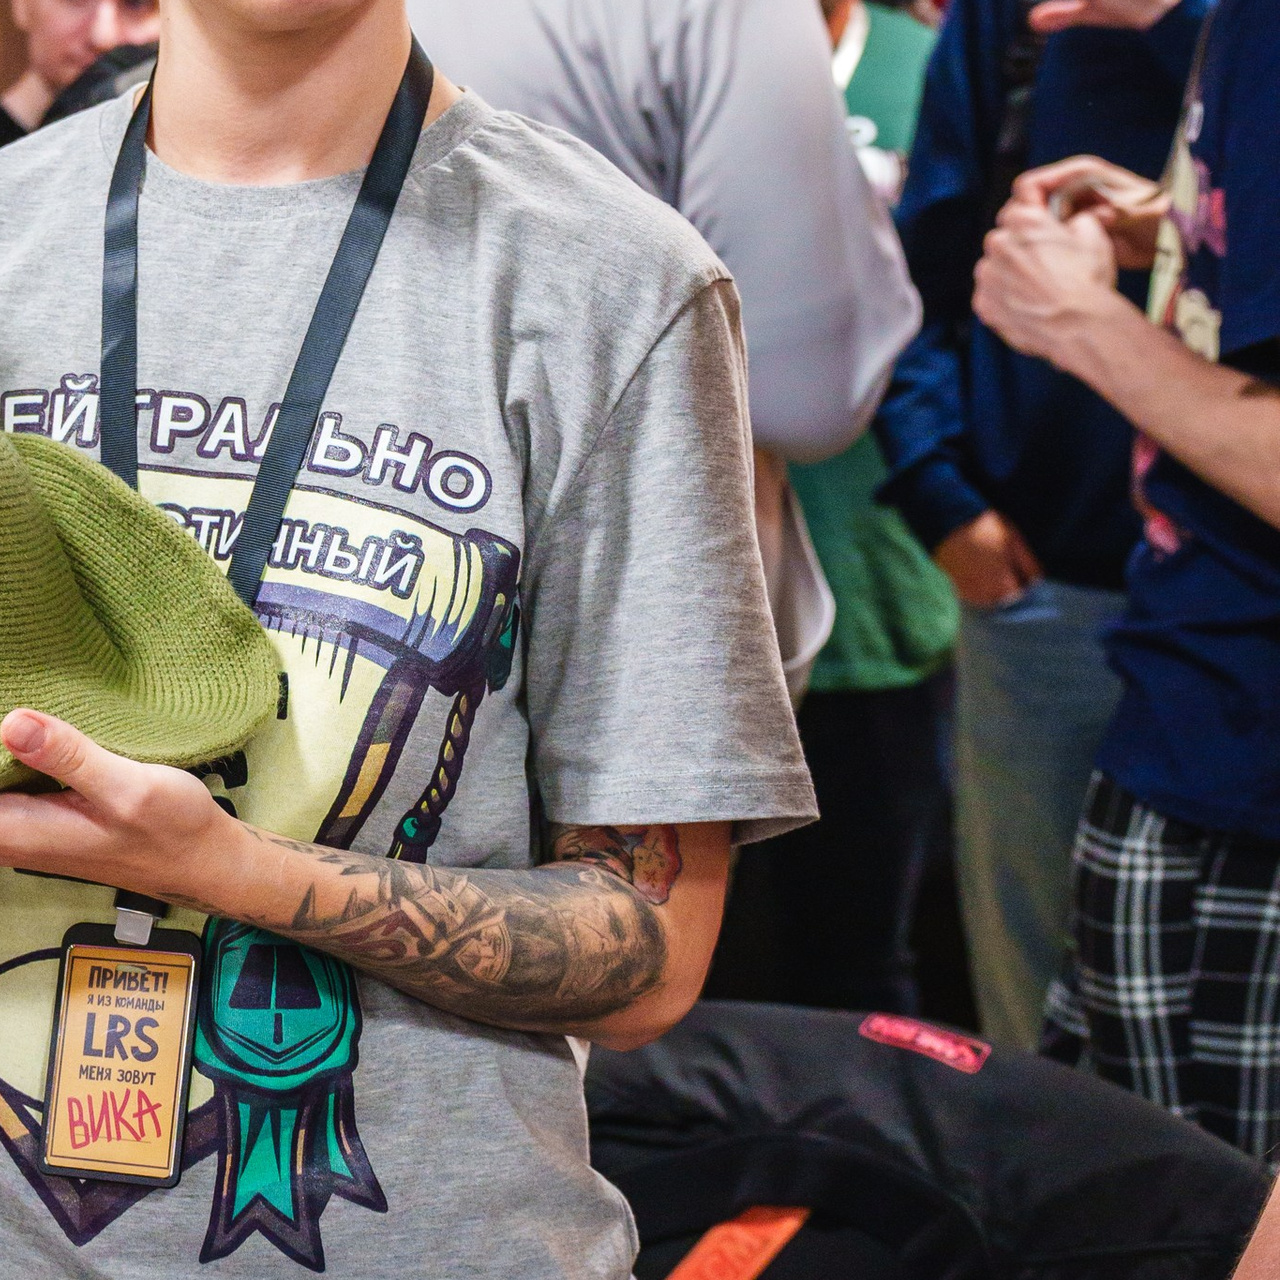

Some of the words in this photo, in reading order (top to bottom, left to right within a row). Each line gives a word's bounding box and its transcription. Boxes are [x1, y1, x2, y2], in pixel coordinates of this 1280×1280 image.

[88, 965, 169, 994] ПРИВЕТ!
[87, 995, 94, 1005] Я
[97, 996, 111, 1007] ИЗ
[115, 996, 165, 1012] КОМАНДЫ
[82, 1012, 160, 1062] LRS
[78, 1064, 112, 1081] МЕНЯ
[116, 1069, 157, 1086] ЗОВУТ
[67, 1088, 162, 1150] ВИКА
